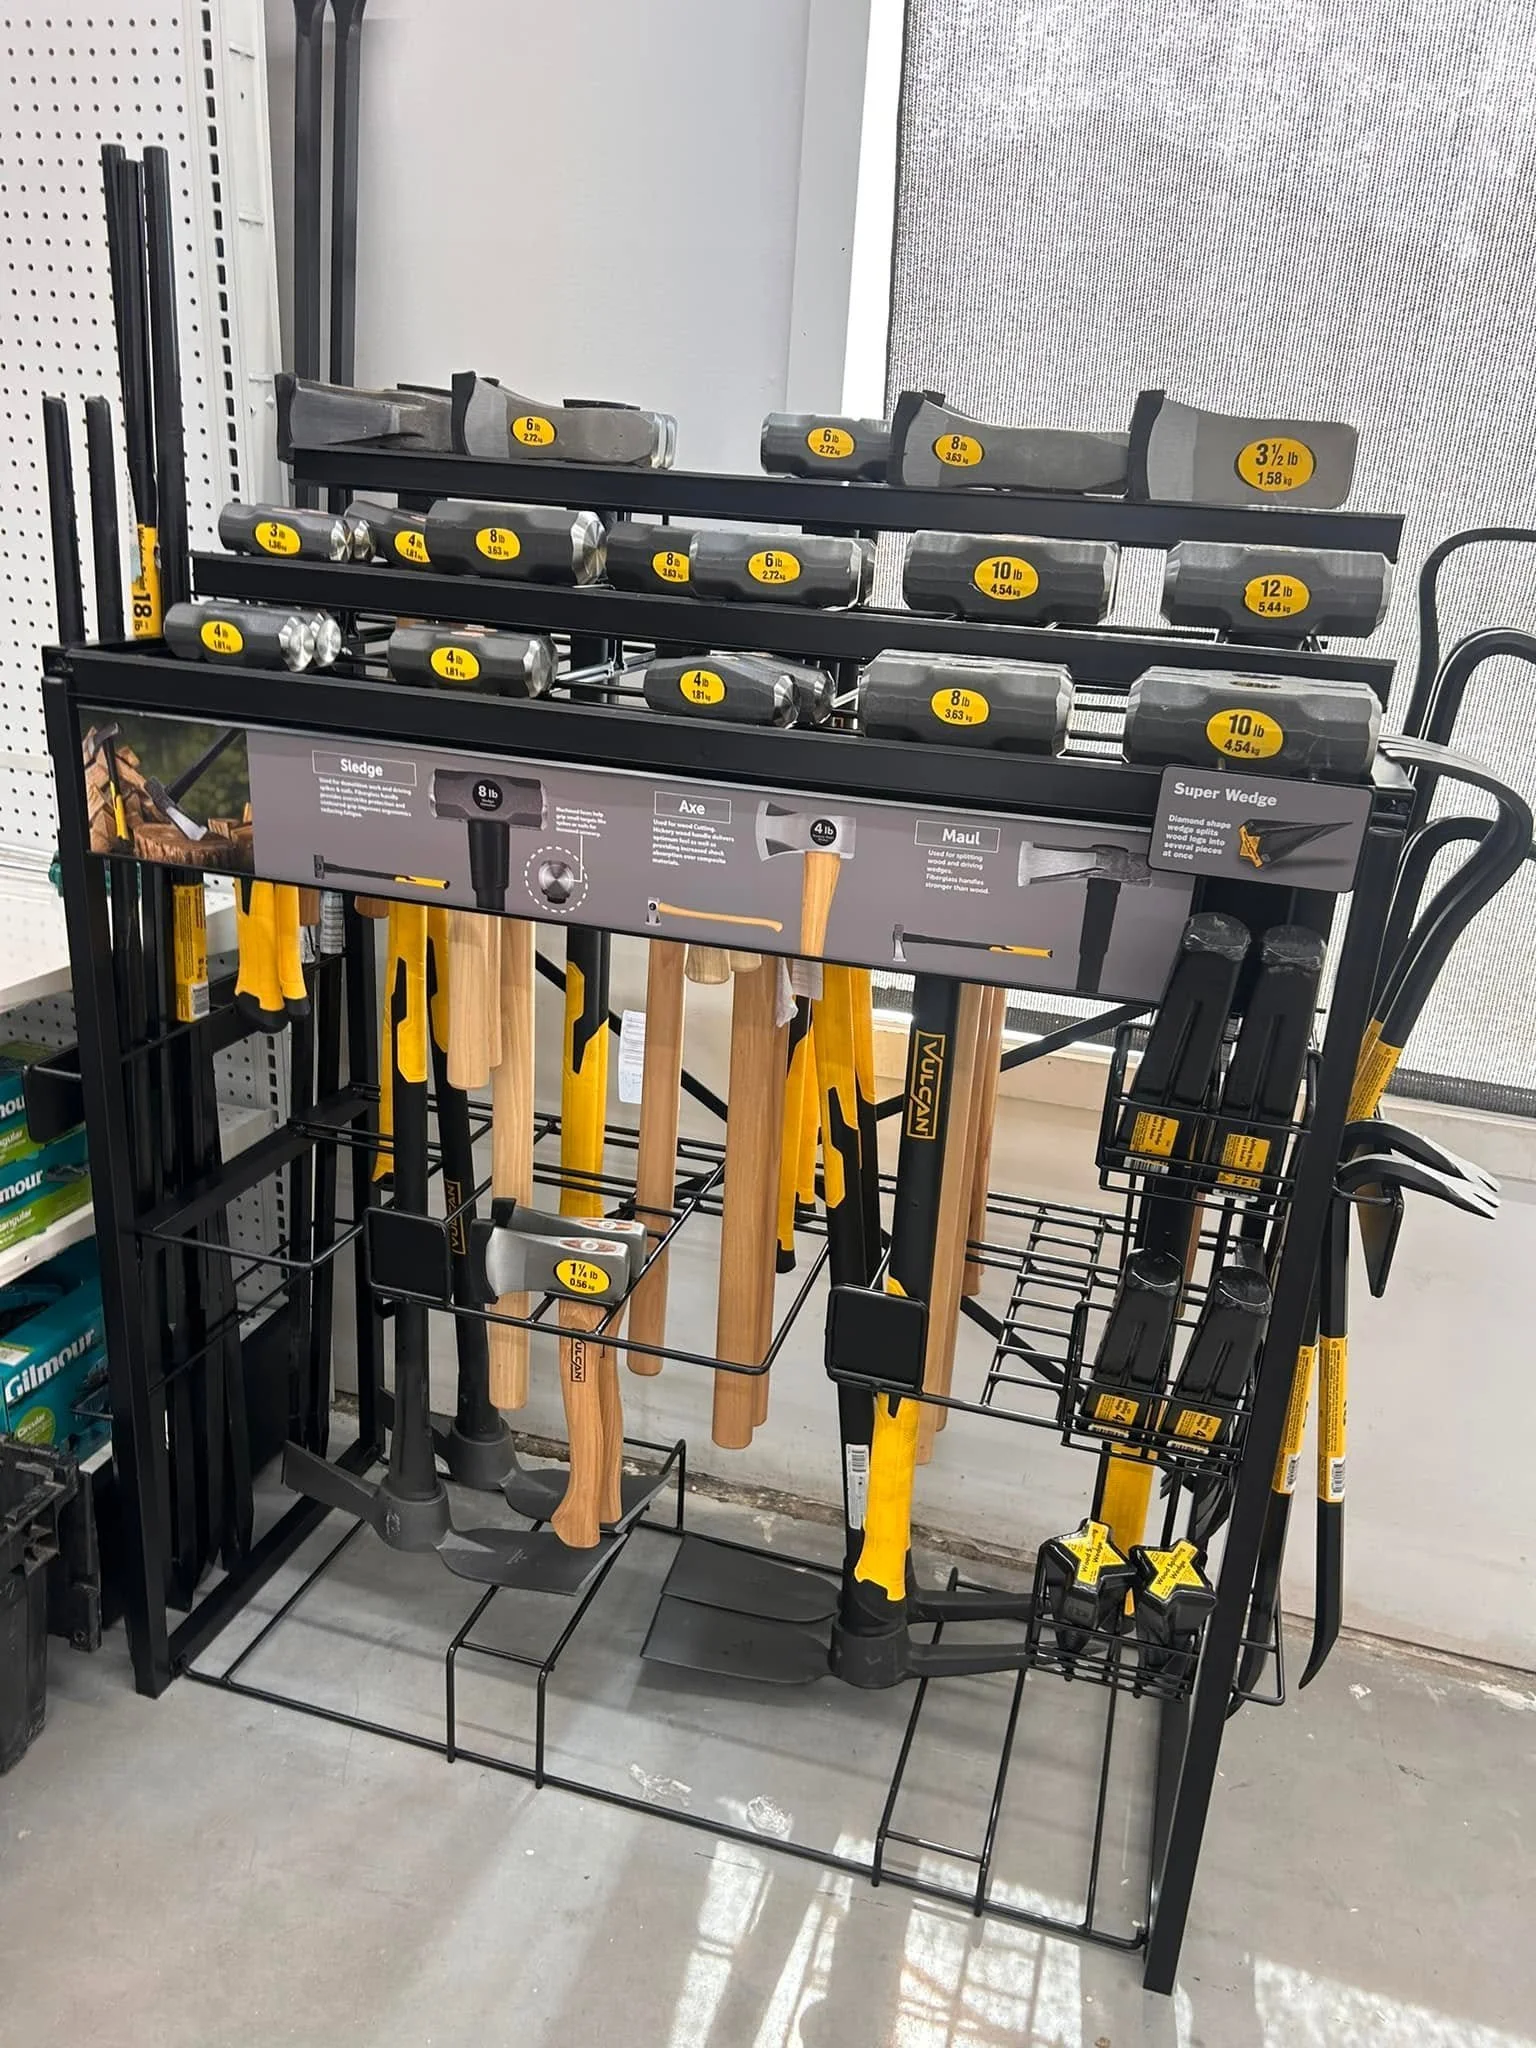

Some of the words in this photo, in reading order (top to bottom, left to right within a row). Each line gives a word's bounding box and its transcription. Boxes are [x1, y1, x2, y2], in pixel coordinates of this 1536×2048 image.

[526, 417, 534, 431] 6
[534, 422, 540, 432] lb
[823, 428, 832, 443] 6
[832, 434, 839, 444] lb
[950, 436, 960, 450] 8
[960, 442, 968, 451] lb
[1287, 450, 1298, 466] lb
[1283, 478, 1292, 488] kg
[270, 524, 278, 537] 3
[278, 530, 286, 539] lb
[490, 530, 498, 543] 8
[498, 534, 505, 544] lb
[408, 534, 415, 546] 4
[416, 540, 422, 548] lb
[666, 552, 674, 566] 8
[674, 558, 680, 566] lb
[765, 552, 774, 568] 6
[774, 558, 782, 568] lb
[992, 561, 1010, 580] 10
[1013, 568, 1022, 581] lb
[1260, 579, 1281, 597] 12
[1284, 585, 1292, 597] lb
[133, 593, 152, 618] 18
[214, 624, 220, 638] 4
[222, 628, 228, 638] lb
[446, 650, 454, 663] 4
[455, 656, 463, 665] lb
[694, 672, 702, 686] 4
[702, 678, 709, 688] lb
[950, 690, 960, 706] 8
[962, 696, 970, 707] lb
[1228, 714, 1252, 736] 10
[1252, 724, 1264, 738] lb
[340, 758, 383, 778] Sledge
[478, 785, 487, 798] 8
[488, 788, 498, 799] lb
[1174, 782, 1220, 799] Super
[1225, 788, 1278, 807] Wedge
[679, 800, 705, 815] Axe
[814, 823, 823, 834] 4
[824, 826, 834, 835] lb
[1168, 814, 1205, 826] Diamond
[1206, 819, 1232, 830] shape
[942, 828, 980, 845] Maul
[1167, 825, 1194, 834] wedge
[1196, 827, 1219, 837] splits
[1166, 834, 1188, 842] wood
[1189, 836, 1207, 844] logs
[1208, 837, 1226, 846] into
[1164, 842, 1193, 851] several
[1195, 845, 1222, 855] pieces
[1173, 852, 1193, 860] once
[956, 853, 983, 862] splitting
[960, 862, 983, 870] driving
[925, 882, 952, 890] stronger
[926, 873, 957, 882] Fiberglass
[959, 877, 984, 885] handles
[914, 1040, 943, 1134] VULCAN
[590, 1270, 598, 1280] lb
[573, 1335, 585, 1380] ULCAN
[4, 1329, 95, 1403] Gilmour
[1092, 1542, 1104, 1563] Wedge
[1156, 1566, 1170, 1585] Wood
[1170, 1560, 1186, 1580] Wedge
